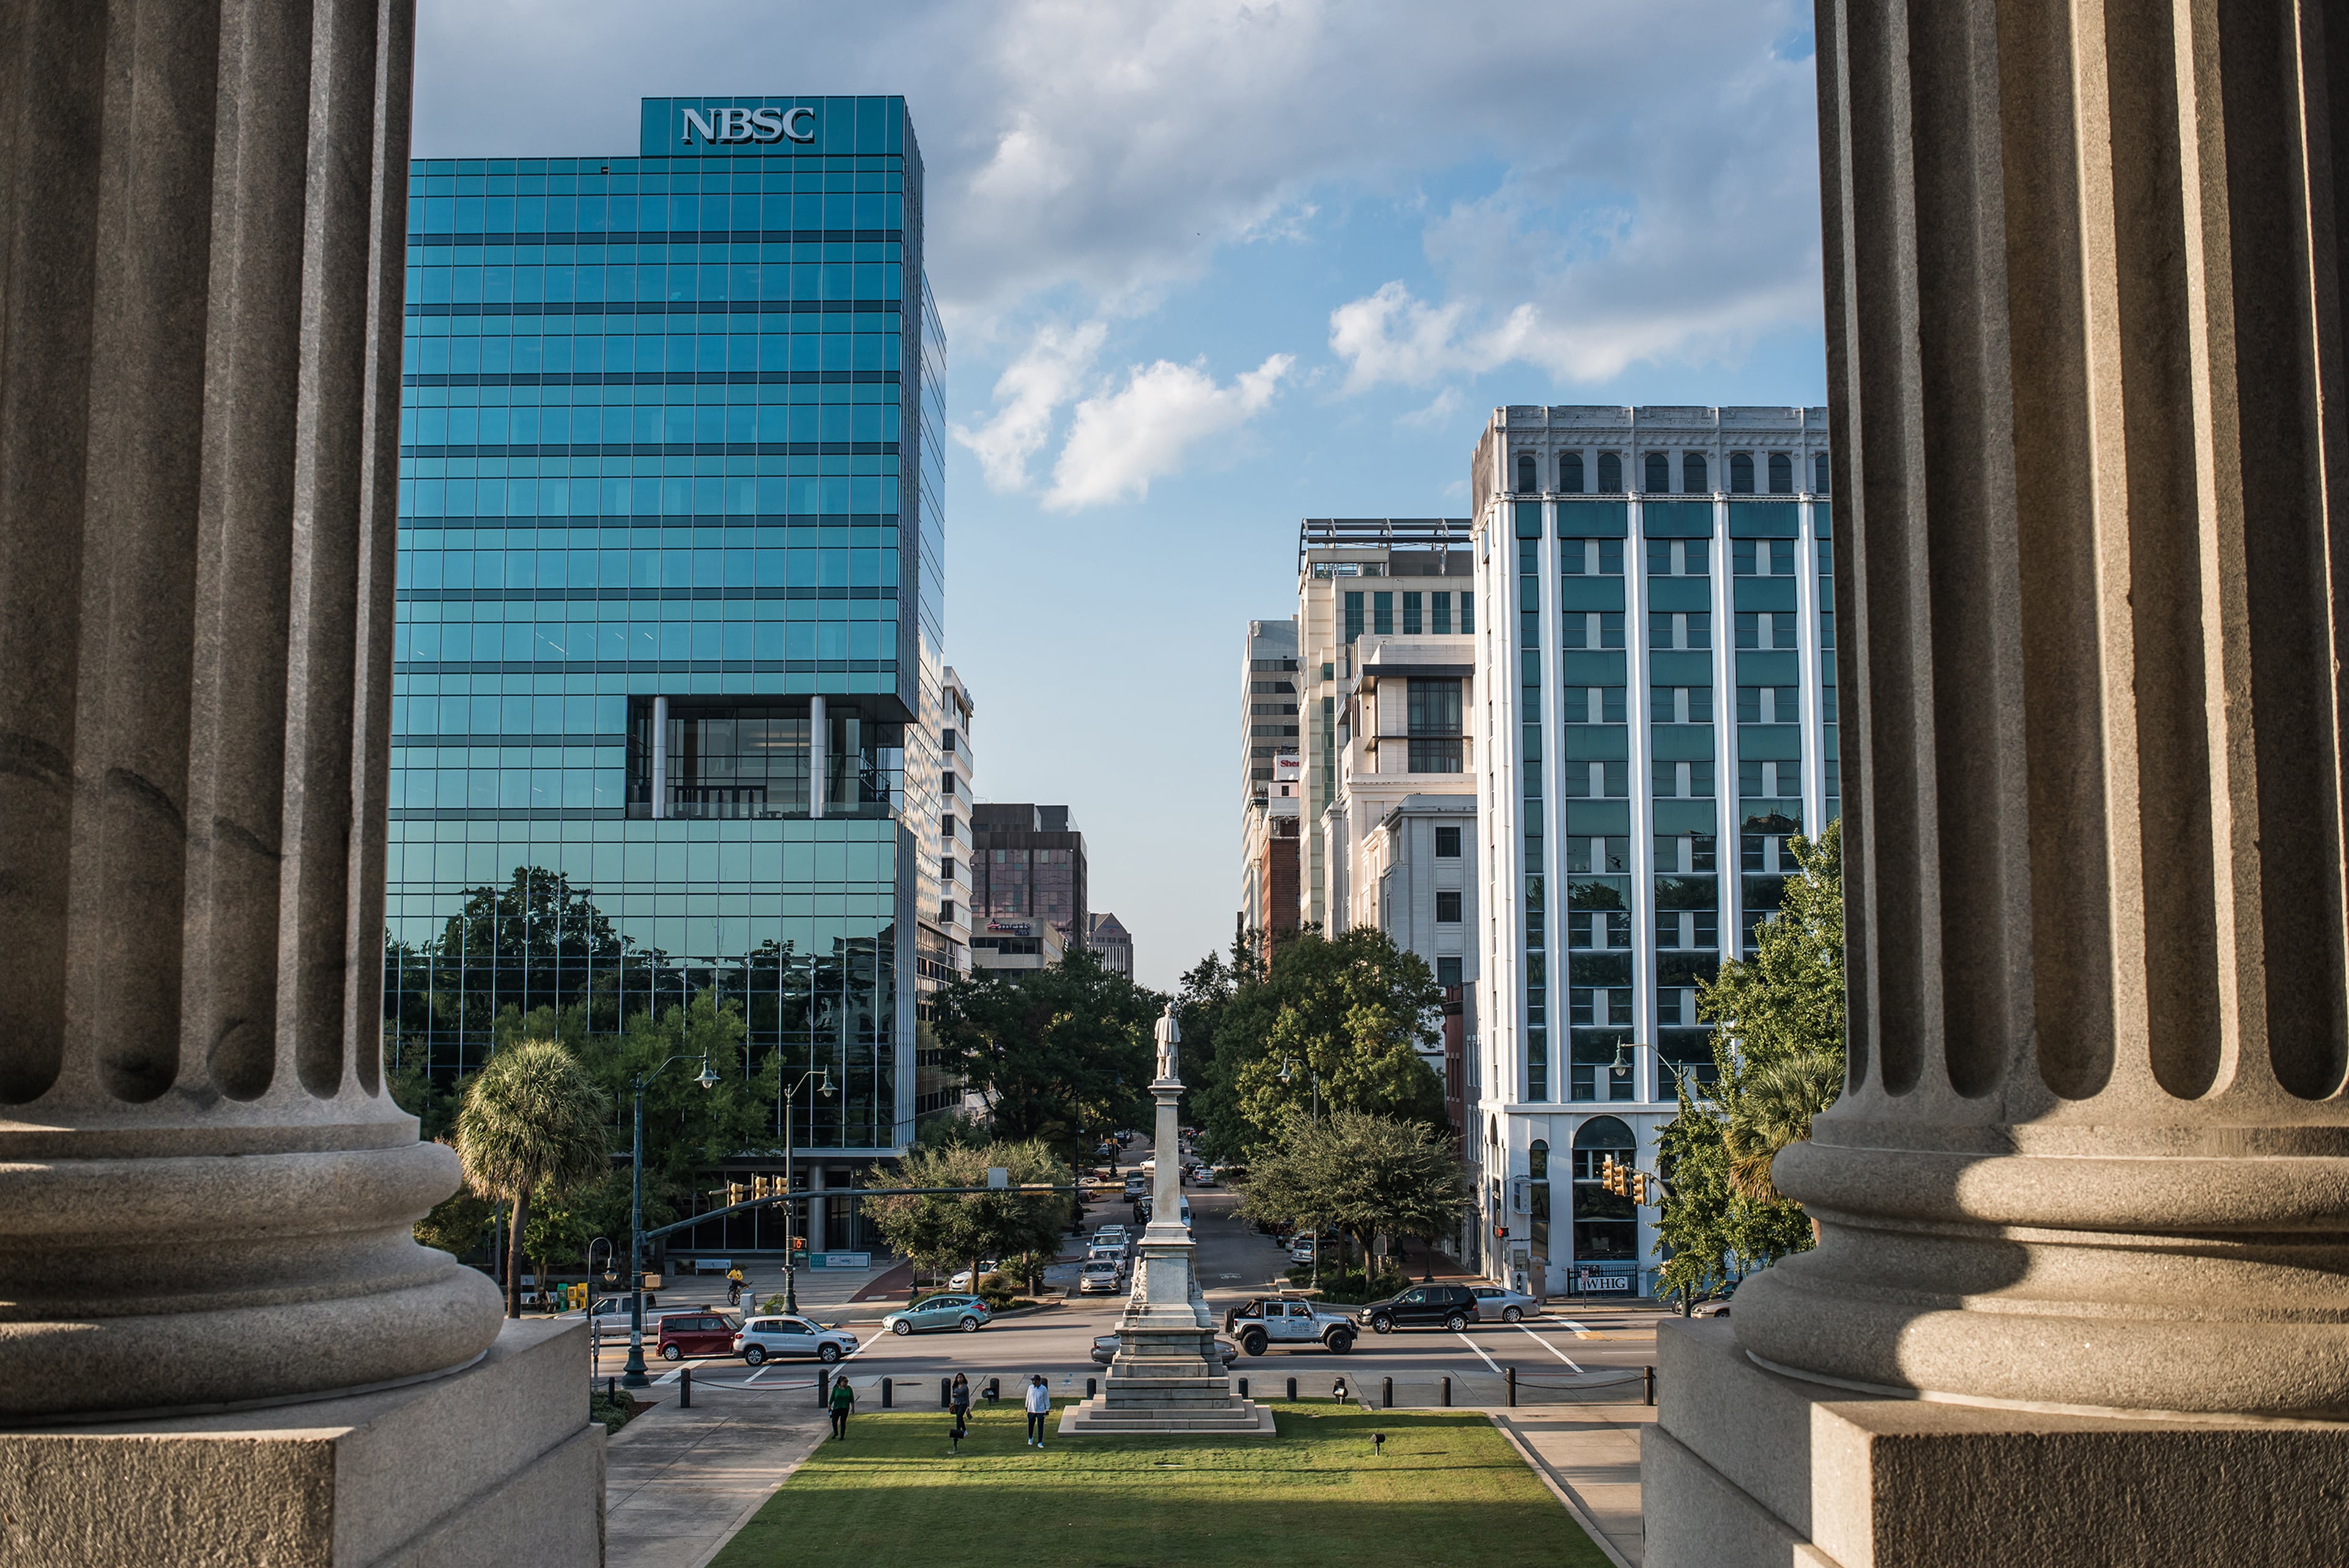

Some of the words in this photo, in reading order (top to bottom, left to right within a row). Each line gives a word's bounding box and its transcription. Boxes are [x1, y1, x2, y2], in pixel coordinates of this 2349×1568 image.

[681, 107, 814, 142] NBSC
[987, 918, 1030, 930] Ameris
[1586, 1278, 1625, 1289] WHIG
